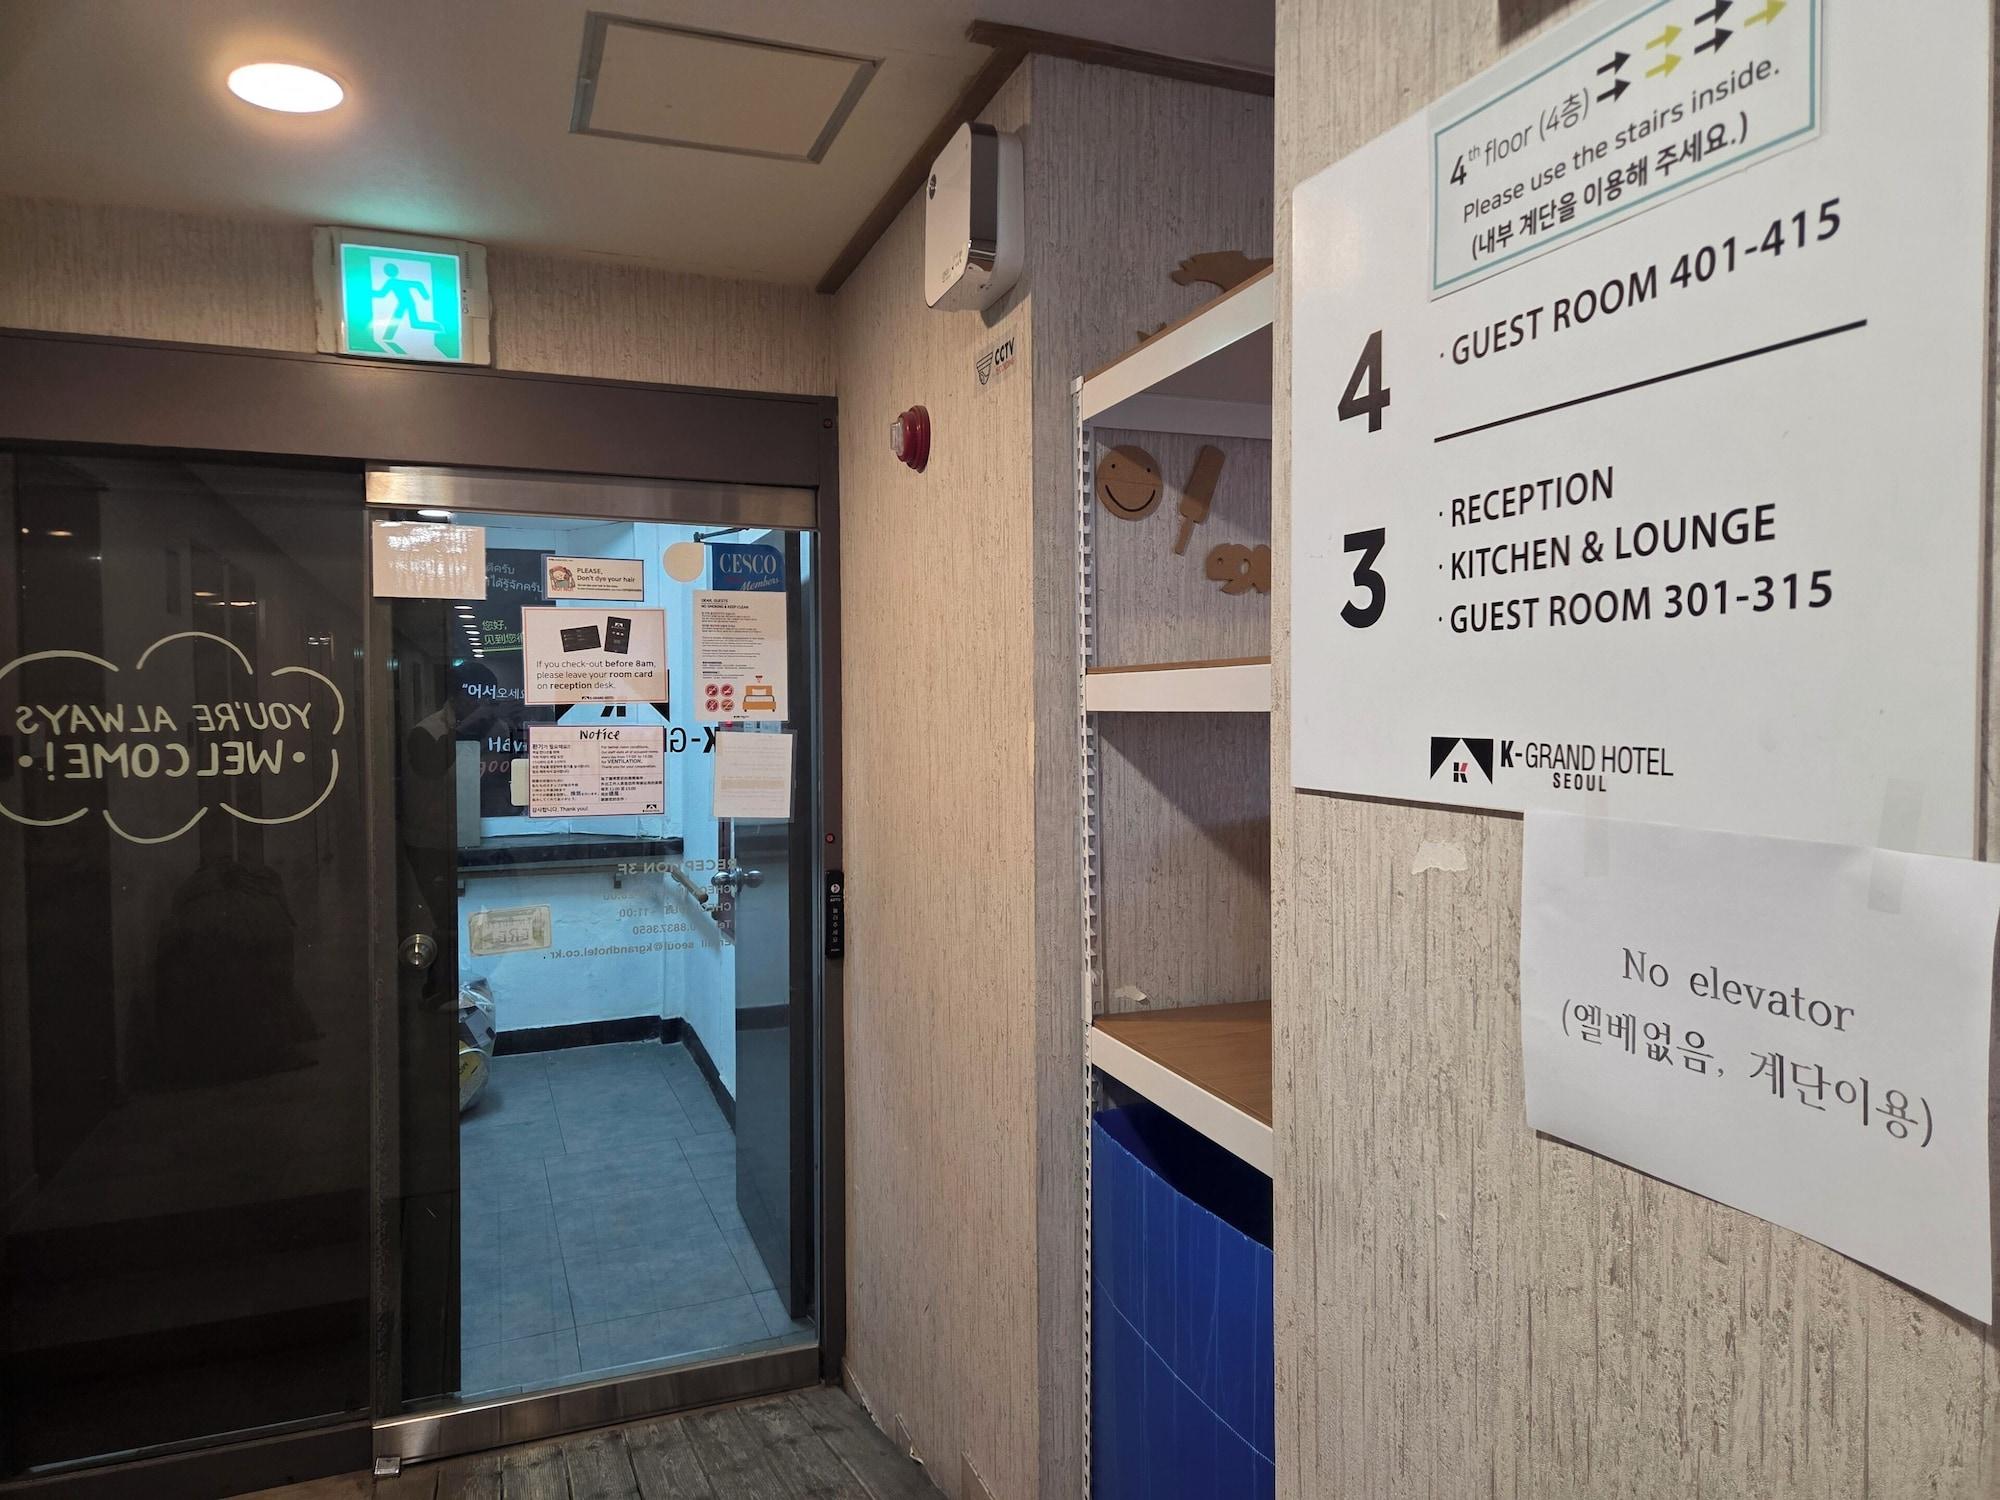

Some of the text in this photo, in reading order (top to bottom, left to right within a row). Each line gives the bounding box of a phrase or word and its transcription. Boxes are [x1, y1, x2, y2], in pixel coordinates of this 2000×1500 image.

[1463, 56, 1780, 225] Please use the stairs inside.
[1486, 126, 1532, 167] floor
[1539, 87, 1590, 142] (4층)
[1472, 111, 1748, 261] (내부 계단을 이용해 주세요.)
[1451, 197, 1841, 367] GUEST ROOM 401-415
[994, 337, 1015, 365] CCTV
[1337, 329, 1390, 433] 4
[1450, 465, 1614, 527] RECEPTION
[719, 553, 777, 574] CESCO
[1450, 503, 1776, 581] KITCHEN & LOUNGE
[1340, 527, 1387, 628] 3
[1450, 569, 1833, 634] GUEST ROOM 301-315
[536, 672, 564, 680] please
[588, 672, 607, 680] your
[544, 662, 559, 670] you
[561, 660, 603, 668] check-out
[605, 660, 634, 668] before
[635, 660, 656, 669] 8am,
[550, 681, 592, 691] reception
[594, 681, 616, 689] desk.
[580, 728, 620, 740] Notice
[1500, 740, 1674, 776] K-GRAND HOTEL
[1552, 772, 1607, 792] SEOUL
[1622, 947, 1855, 1033] No elevator
[1561, 998, 1934, 1148] (엘베없음, 계단이용)
